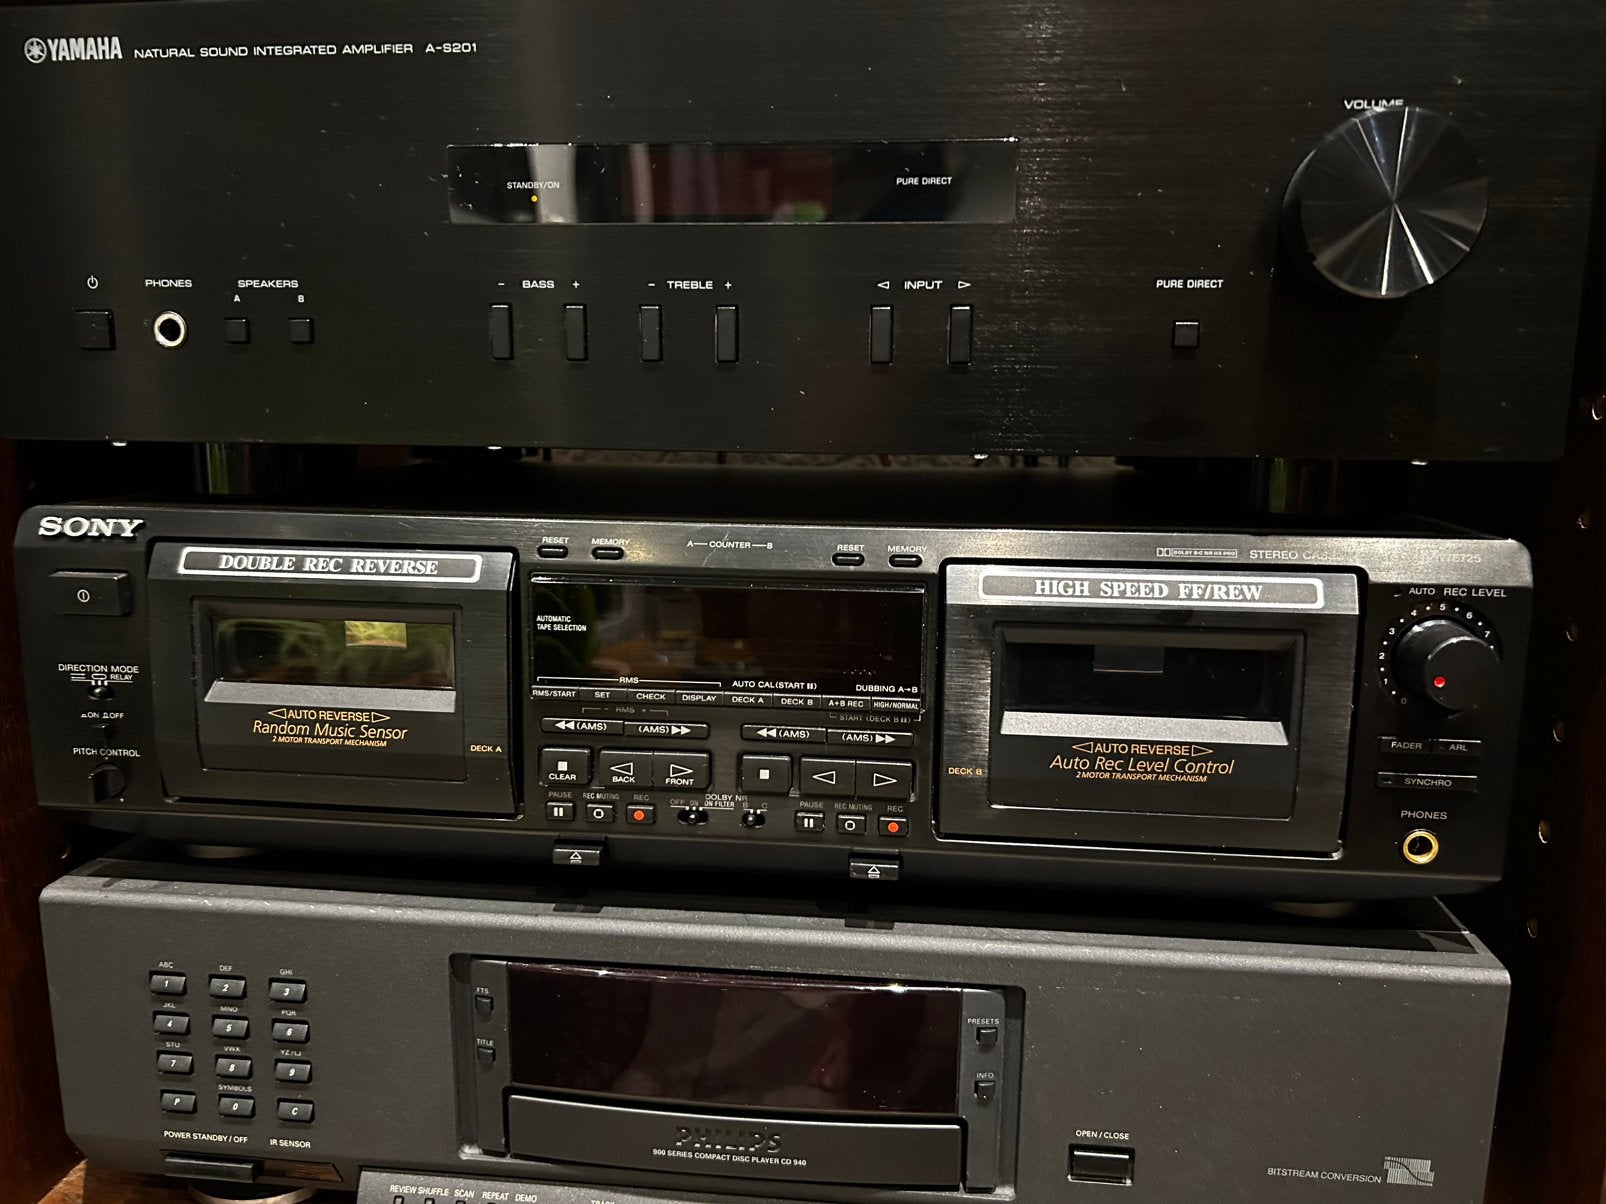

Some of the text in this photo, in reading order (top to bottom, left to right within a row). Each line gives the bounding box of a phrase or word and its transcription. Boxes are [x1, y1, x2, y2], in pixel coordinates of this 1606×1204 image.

[46, 37, 122, 61] YAMAHA
[134, 42, 478, 58] NATURAL SOUND INTEGRATED AMPLIFIER A-S201
[1344, 99, 1404, 110] VOLUME
[506, 181, 560, 189] STANDBY/ON
[896, 177, 952, 186] PURE DIRECT
[145, 279, 192, 288] PHONES
[237, 279, 298, 288] SPEAKERS
[522, 280, 554, 290] BASS
[667, 280, 713, 290] TREBLE
[904, 280, 942, 290] INPUT
[1156, 279, 1223, 288] PURE DIRECT
[234, 295, 240, 303] A
[298, 295, 304, 303] B
[39, 516, 144, 537] SONY
[1249, 550, 1298, 559] STEREO
[219, 554, 439, 574] DOUBLE REC REVERSE
[1034, 580, 1262, 600] HIGH SPEED FF/REW
[1409, 587, 1436, 596] AUTO
[1444, 588, 1507, 597] REC LEVEL
[1379, 652, 1385, 660] 2
[58, 663, 139, 673] DIRECTION MODE
[856, 684, 895, 692] DUBBING
[533, 690, 576, 698] RMS/START
[682, 694, 716, 702] DISPLAY
[288, 709, 370, 722] AUTO REVERSE
[253, 719, 408, 740] Random Music Sensor
[576, 722, 607, 731] (AMS)
[639, 725, 669, 734] (AMS)
[779, 730, 810, 739] (AMS)
[841, 733, 874, 743] (AMS)
[278, 736, 387, 747] MOTOR TRANSPORT MECHANISM
[1391, 742, 1422, 750] FADER
[470, 744, 492, 752] DECK
[1095, 742, 1190, 756] AUTO REVERSE
[1449, 743, 1468, 751] ARL
[73, 747, 140, 757] PITCH CONTROL
[1050, 754, 1234, 775] Auto Rec Level Control
[948, 766, 982, 776] DECK B
[548, 773, 576, 781] CLEAR
[1081, 772, 1207, 783] MOTOR TRANSPORT MECHANISM
[665, 778, 694, 786] FRONT
[1404, 778, 1452, 787] SYNCHRO
[1401, 810, 1447, 820] PHONES
[223, 984, 229, 992] 2
[284, 988, 290, 996] 3
[476, 987, 489, 995] FTS
[226, 1024, 232, 1032] 5
[286, 1028, 292, 1036] 6
[476, 1038, 494, 1046] TITLE
[170, 1059, 176, 1068] 7
[218, 1084, 252, 1092] SYMBOLS
[174, 1098, 180, 1106] P
[292, 1107, 298, 1115] C
[164, 1131, 248, 1143] POWER STANDBY OFF
[1075, 1129, 1129, 1140] OPEN CLOSE
[279, 1139, 311, 1148] SENSOR
[652, 1148, 666, 1156] 900
[667, 1150, 692, 1158] SERIES
[694, 1152, 730, 1161] COMPACT
[732, 1154, 750, 1162] DISC
[751, 1156, 779, 1165] PLAYER
[780, 1157, 792, 1165] CD
[1267, 1168, 1381, 1183] BITSTREAM CONVERSION
[390, 1185, 537, 1202] REVIEW SHUFFLE SCAN REPEAT DEMO
